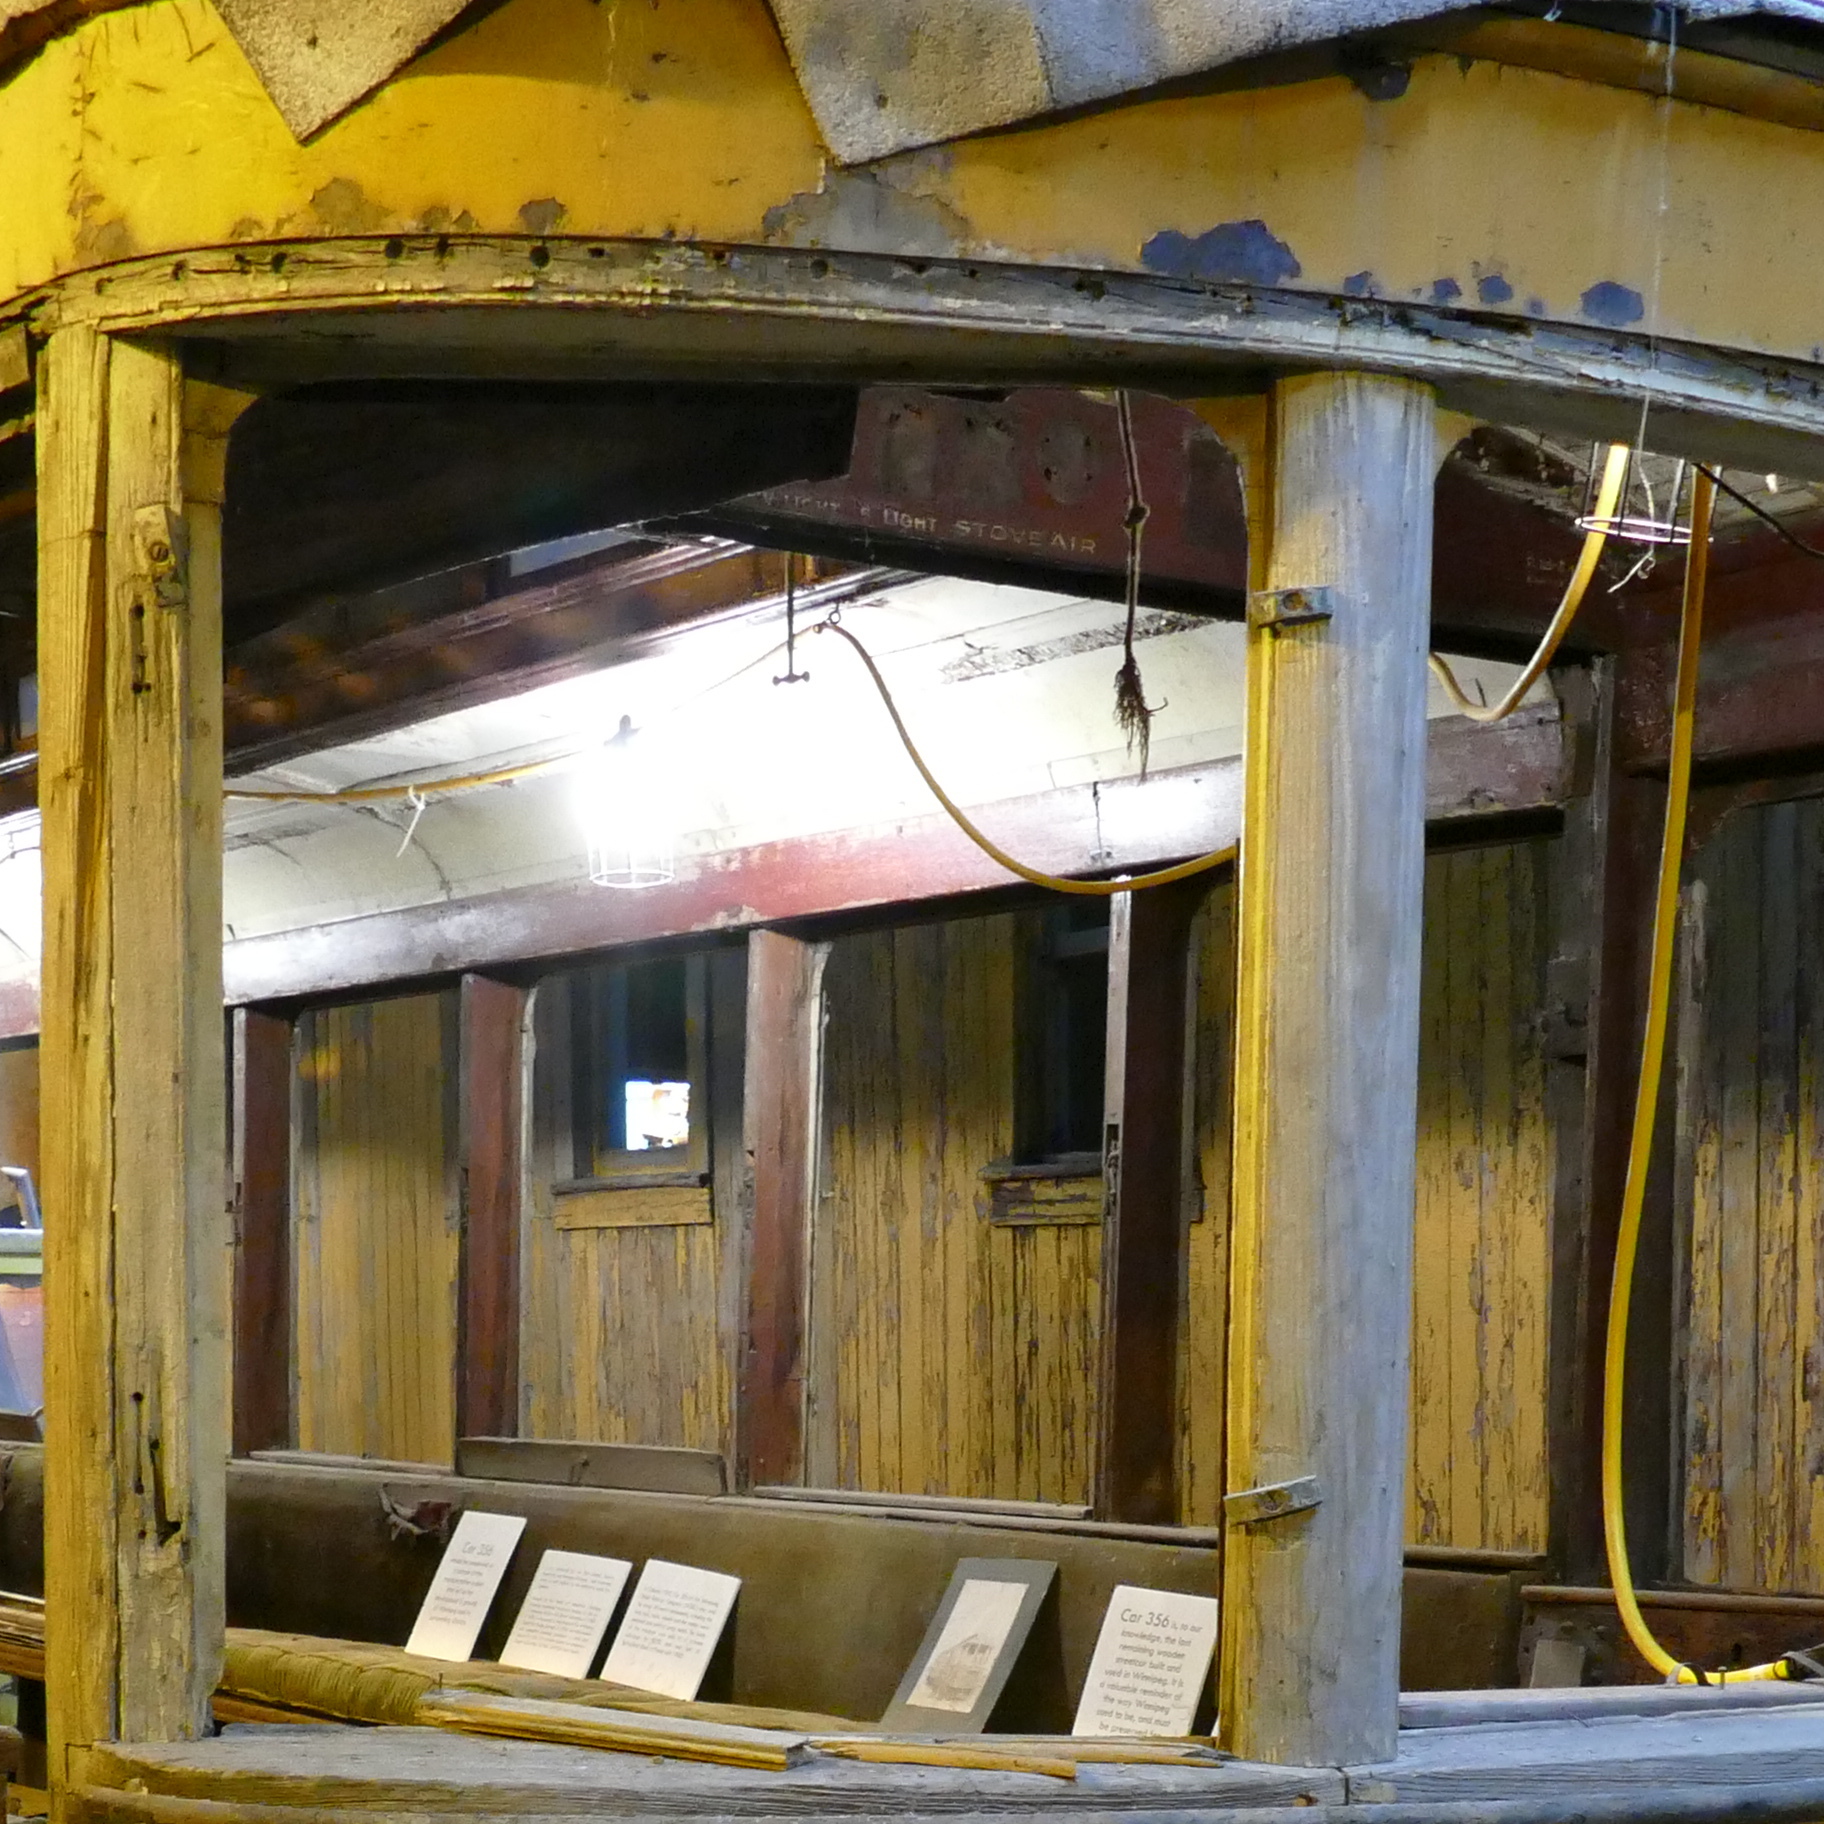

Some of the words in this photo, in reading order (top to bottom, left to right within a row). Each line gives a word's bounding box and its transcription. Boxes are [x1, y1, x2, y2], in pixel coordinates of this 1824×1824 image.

[954, 519, 1042, 547] STOVE
[1052, 534, 1097, 555] AIR
[1121, 1608, 1142, 1622] Car
[1145, 1612, 1169, 1628] 356
[1181, 1624, 1188, 1632] to
[1121, 1629, 1163, 1644] knowledge,
[1165, 1636, 1176, 1644] the
[1178, 1637, 1191, 1647] last
[1119, 1643, 1154, 1657] remaining
[1157, 1651, 1185, 1659] wooden
[1104, 1668, 1121, 1677] used
[1115, 1657, 1147, 1666] streetcar
[1149, 1661, 1165, 1669] built
[1167, 1664, 1182, 1673] and
[1107, 1683, 1138, 1693] valuable
[1139, 1688, 1172, 1699] reminder
[1174, 1692, 1183, 1701] of
[1103, 1694, 1114, 1703] the
[1117, 1697, 1132, 1707] way
[1135, 1699, 1171, 1714] Winnipeg
[1096, 1708, 1113, 1718] used
[1138, 1716, 1152, 1725] and
[1154, 1718, 1171, 1727] must
[1099, 1722, 1109, 1731] be
